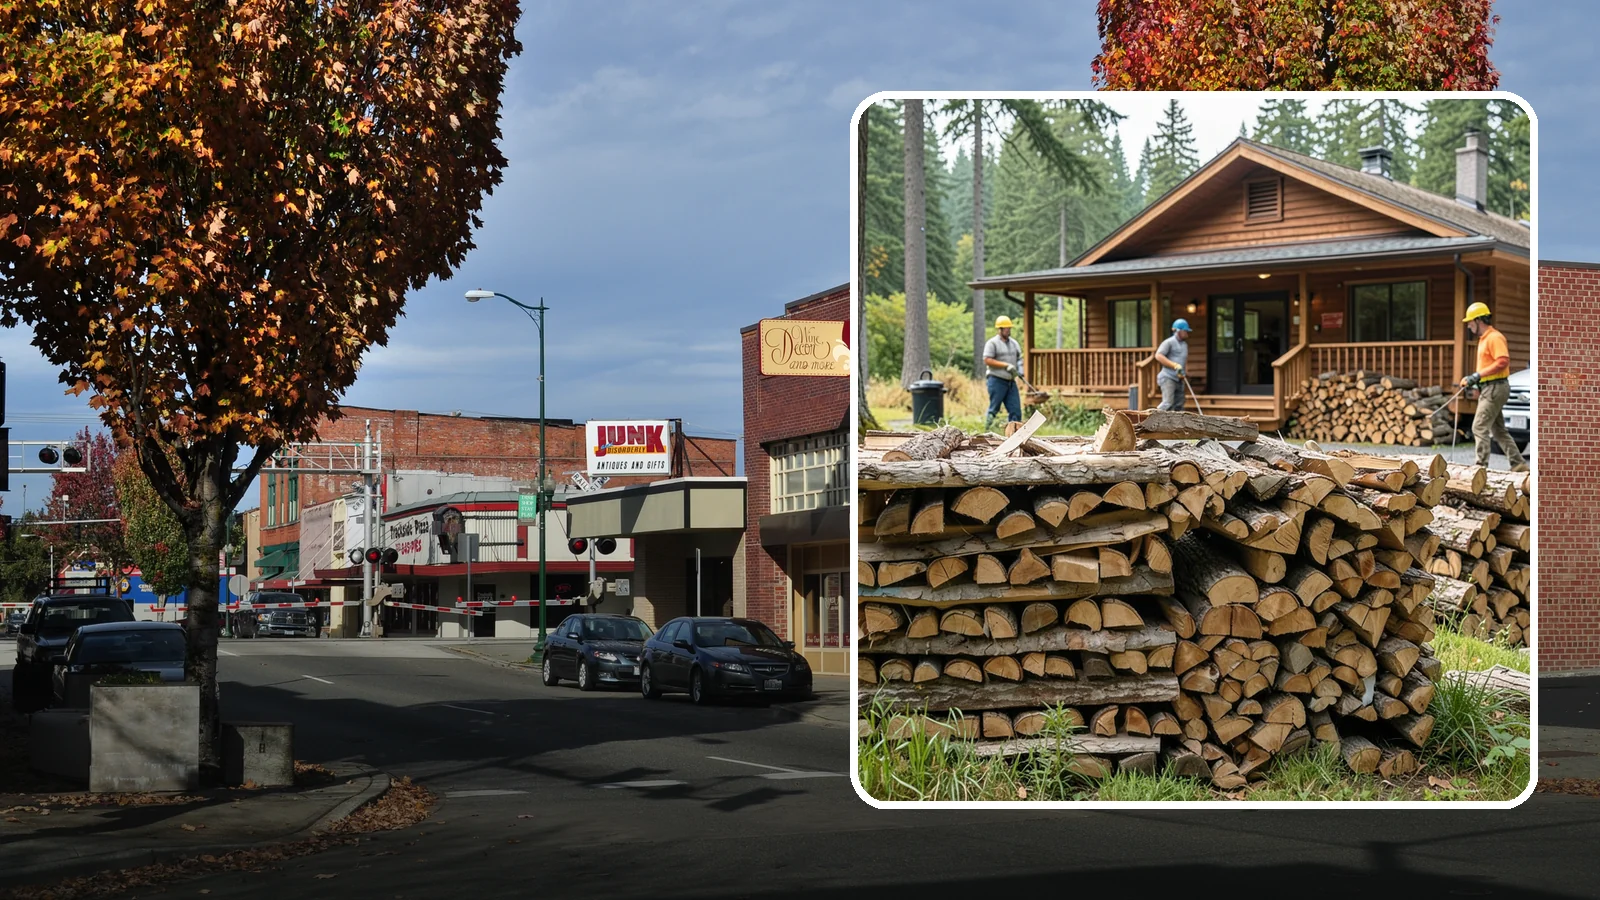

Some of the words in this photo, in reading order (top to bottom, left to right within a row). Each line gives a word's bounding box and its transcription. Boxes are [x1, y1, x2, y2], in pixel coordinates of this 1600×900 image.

[595, 425, 665, 457] JUNK
[596, 461, 629, 470] ANTIQUES
[631, 461, 644, 470] AND
[646, 460, 666, 470] GIFTS
[414, 519, 429, 535] Pizza
